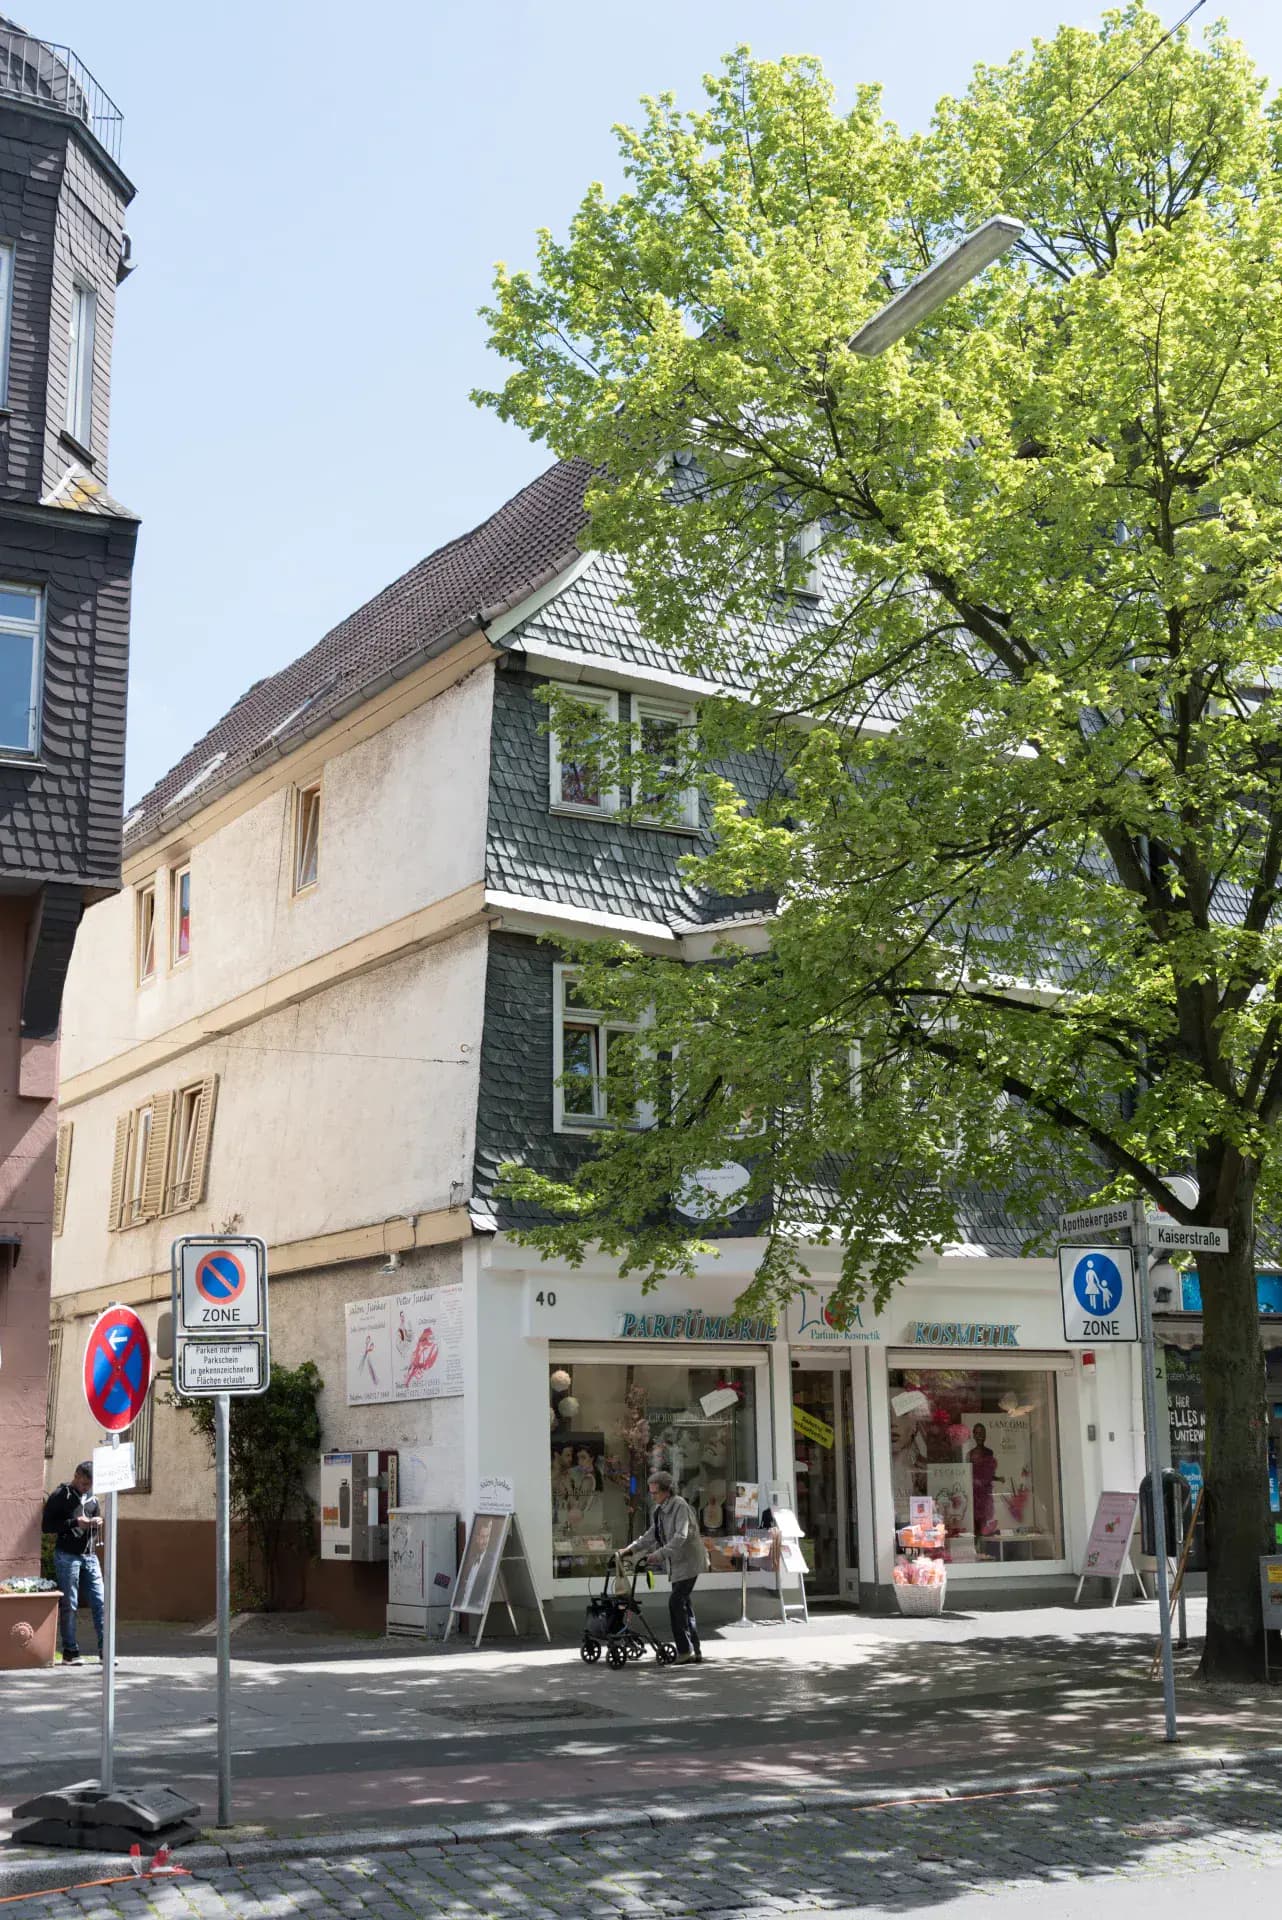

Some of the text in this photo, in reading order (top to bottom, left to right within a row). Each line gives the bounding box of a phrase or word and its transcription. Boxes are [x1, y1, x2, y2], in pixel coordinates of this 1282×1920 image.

[1062, 1209, 1128, 1233] Apothekergasse
[1158, 1227, 1221, 1247] Kaiserstraße
[536, 1291, 557, 1306] 40
[202, 1308, 241, 1322] ZONE
[621, 1308, 778, 1341] PARFÜMERIE
[1082, 1320, 1120, 1336] ZONE
[913, 1321, 1021, 1346] KOSMETIK
[196, 1346, 218, 1354] Parken
[198, 1366, 254, 1376] gekennzeichneten
[197, 1376, 246, 1385] Flächen erlaubt
[1168, 1410, 1198, 1427] ELLES
